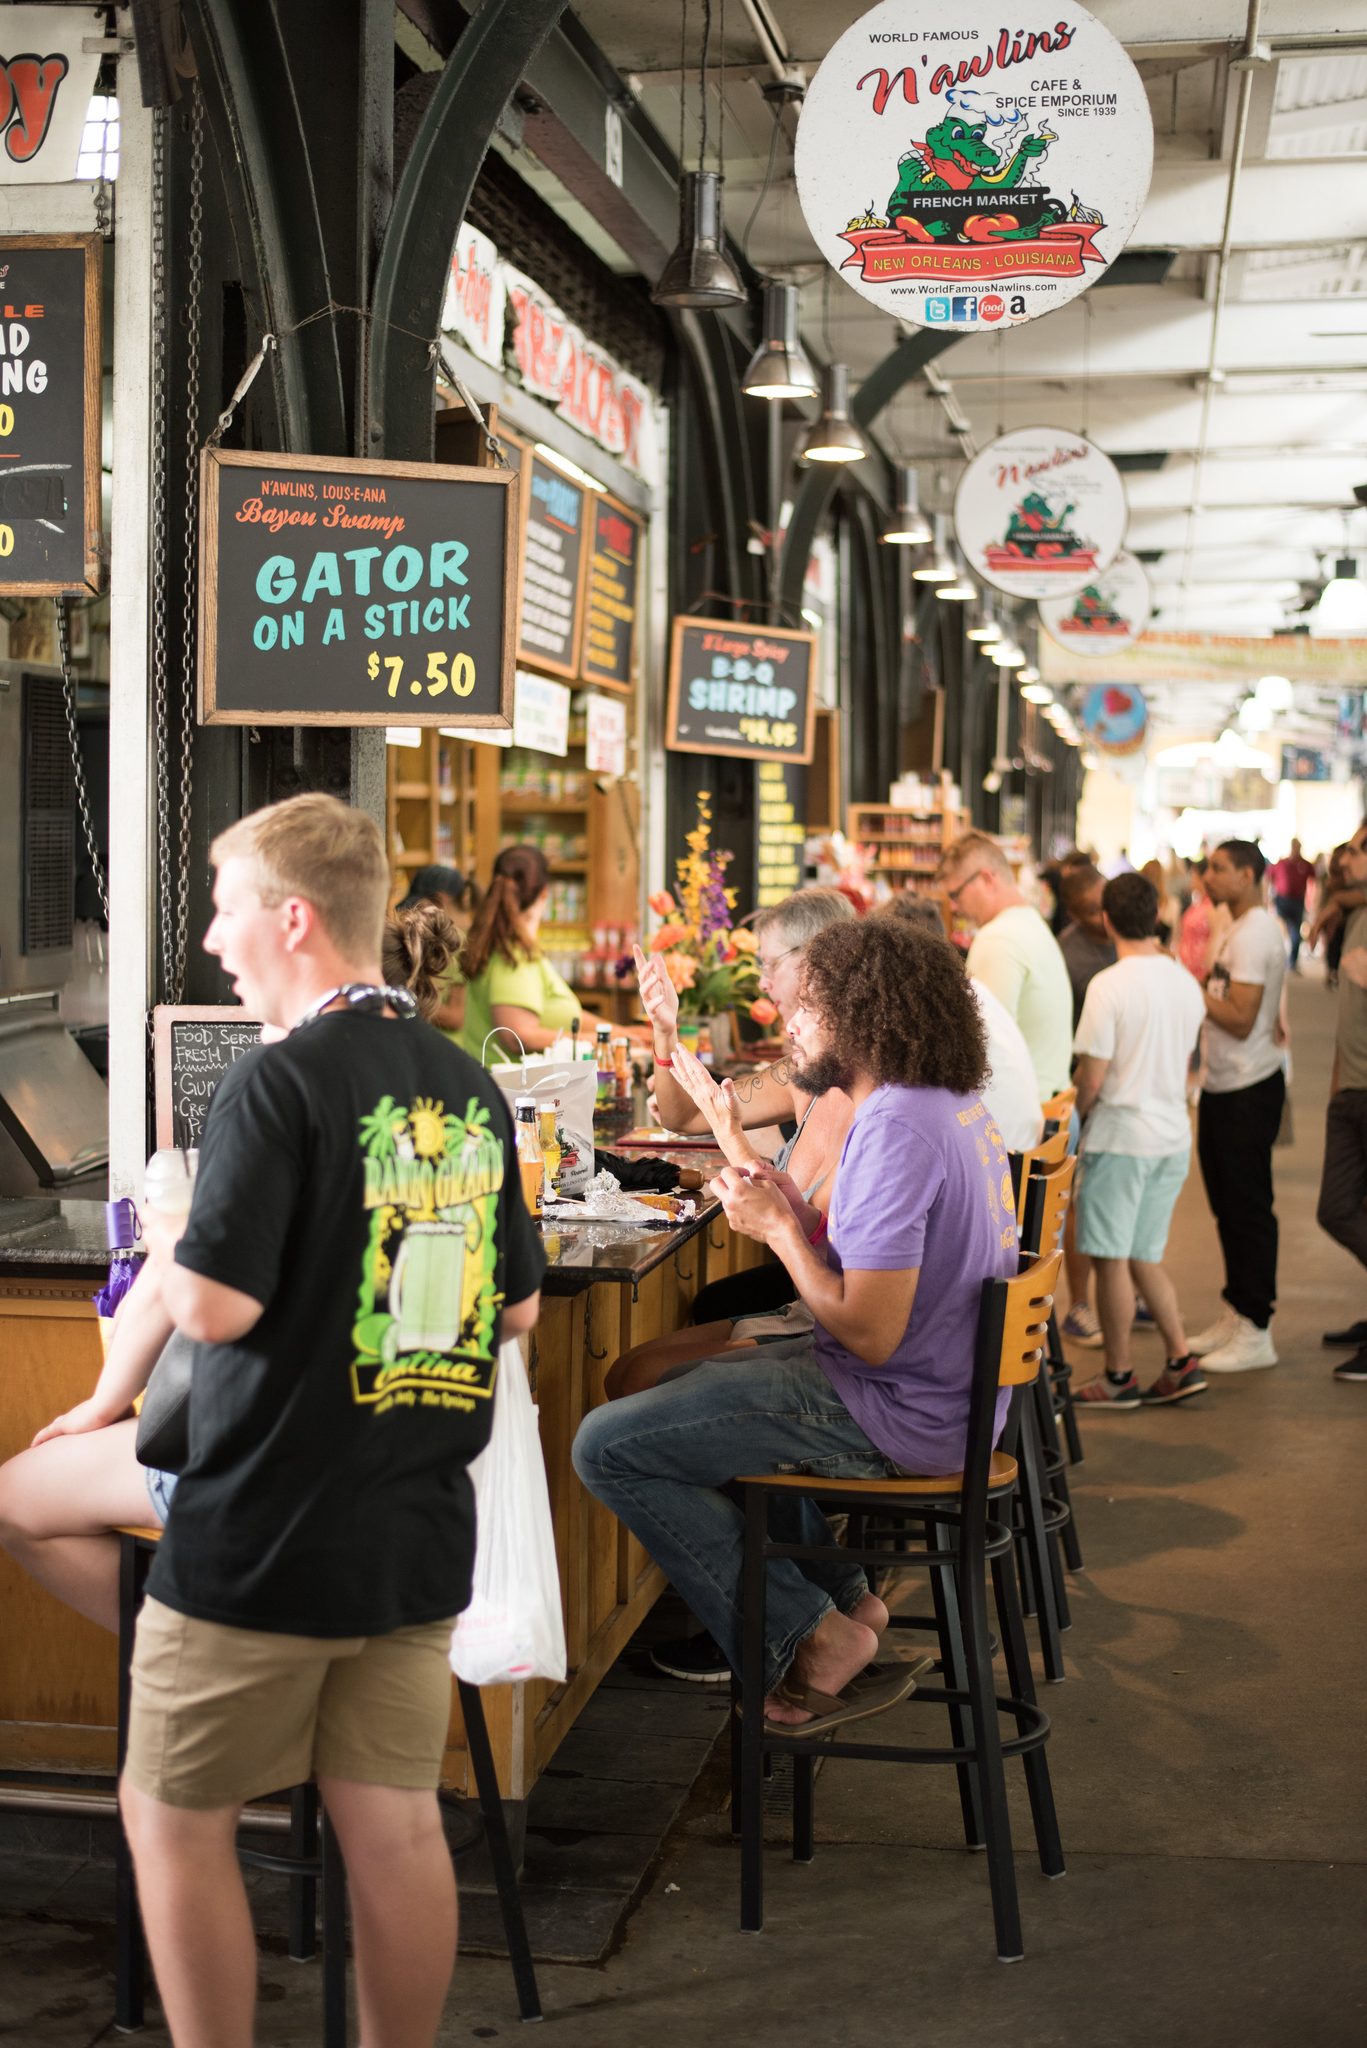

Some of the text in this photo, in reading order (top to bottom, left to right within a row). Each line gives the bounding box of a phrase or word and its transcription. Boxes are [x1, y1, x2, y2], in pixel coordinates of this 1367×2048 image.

[869, 30, 979, 43] WORLD FAMOUS
[1030, 78, 1082, 92] CAFE &
[995, 93, 1118, 109] SPICE EMPORIUM
[1057, 106, 1117, 118] SINCE 1939
[913, 194, 1038, 209] FRENCH MARKET
[873, 252, 1076, 271] NEW ORLEANS LOUISIANA
[890, 283, 1058, 296] www.WorldFamousNawlins.com
[261, 481, 318, 501] N'AWLINS,
[236, 497, 406, 540] Bayou Swamp
[255, 540, 470, 604] GATOR
[252, 594, 471, 651] ON A STICK
[367, 651, 477, 698] $7.50
[688, 677, 797, 719] SHRIMP
[174, 1027, 213, 1046] FOOD
[175, 1046, 222, 1064] FRESH
